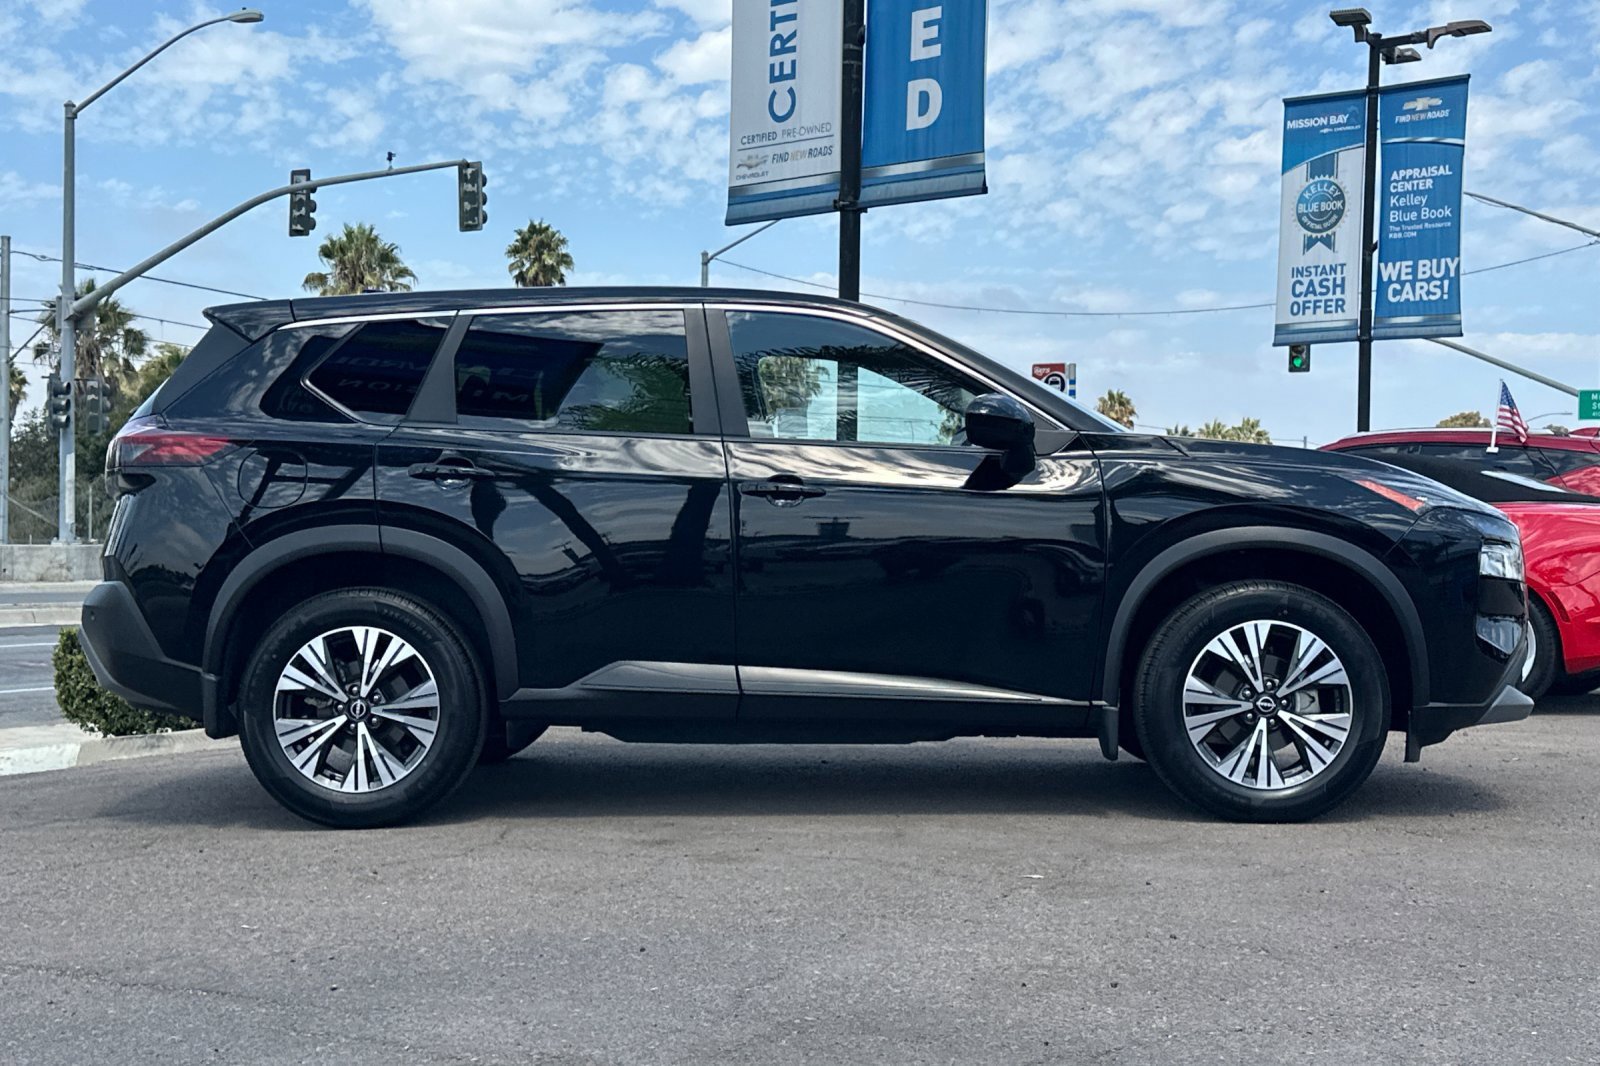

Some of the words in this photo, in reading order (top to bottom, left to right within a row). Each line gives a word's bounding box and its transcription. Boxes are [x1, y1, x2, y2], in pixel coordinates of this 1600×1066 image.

[1287, 116, 1327, 129] MISSION
[1330, 114, 1349, 125] BAY
[1395, 114, 1410, 124] FIND
[1411, 113, 1427, 121] NEW
[1427, 109, 1450, 119] ROADS
[740, 131, 778, 146] CERTIFIED
[781, 122, 832, 139] PRE-OWNED
[771, 151, 790, 165] FIND
[790, 149, 808, 161] NEW
[807, 145, 833, 159] ROADS
[1391, 164, 1453, 181] APPRAISAL
[1302, 182, 1341, 200] KELLEY
[1390, 178, 1433, 193] CENTER
[1298, 202, 1319, 214] BLUE
[1320, 200, 1344, 212] BOOK
[1390, 193, 1428, 207] Kelley
[1389, 210, 1418, 223] Blue
[1421, 205, 1452, 220] Book
[1401, 223, 1423, 231] Trusted
[1424, 221, 1451, 229] Resource
[1291, 263, 1346, 278] INSTANT
[1379, 260, 1414, 282] WE
[1417, 257, 1460, 280] BUY
[1291, 277, 1346, 298] CASH
[1387, 280, 1449, 302] CARS!
[1290, 298, 1346, 316] OFFER
